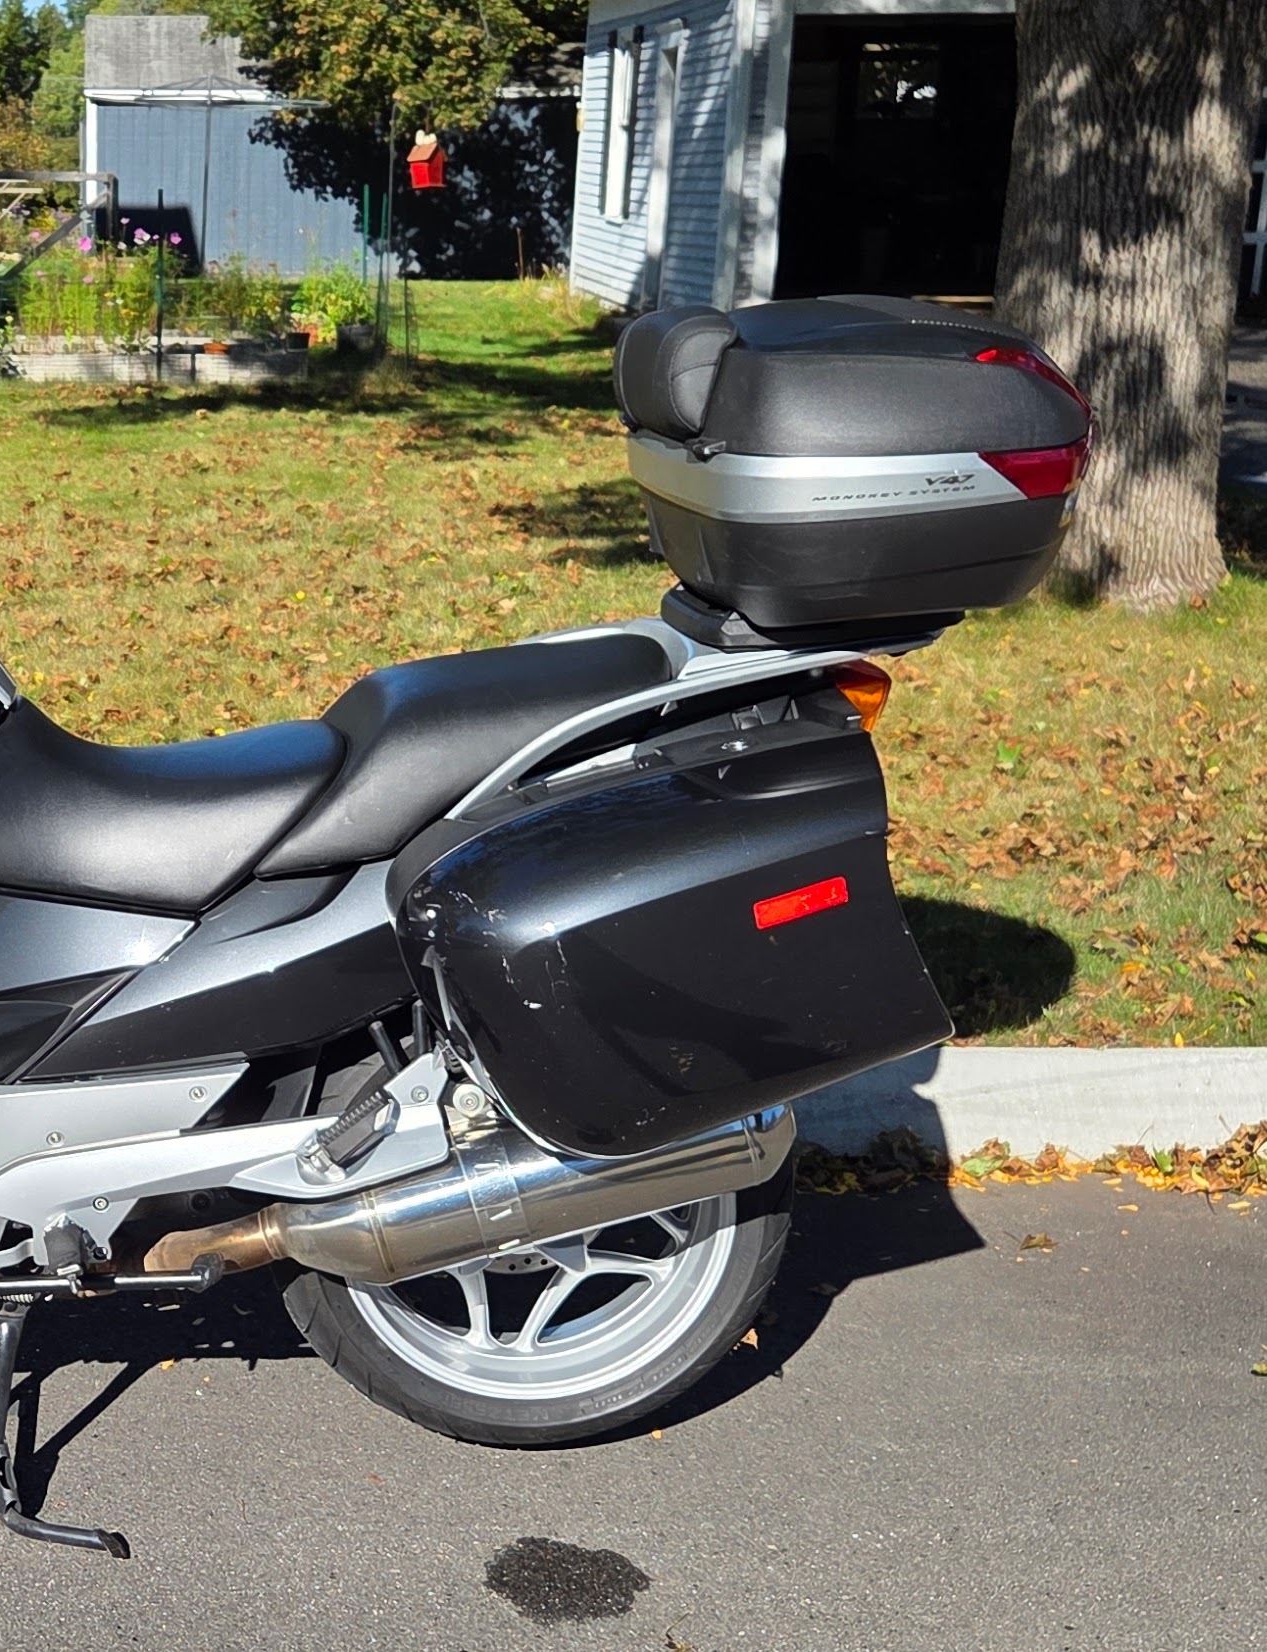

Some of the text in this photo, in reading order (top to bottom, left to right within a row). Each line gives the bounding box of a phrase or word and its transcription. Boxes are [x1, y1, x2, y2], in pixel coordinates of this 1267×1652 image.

[925, 473, 976, 486] V47
[812, 485, 976, 501] MONOKEY SYSTEM
